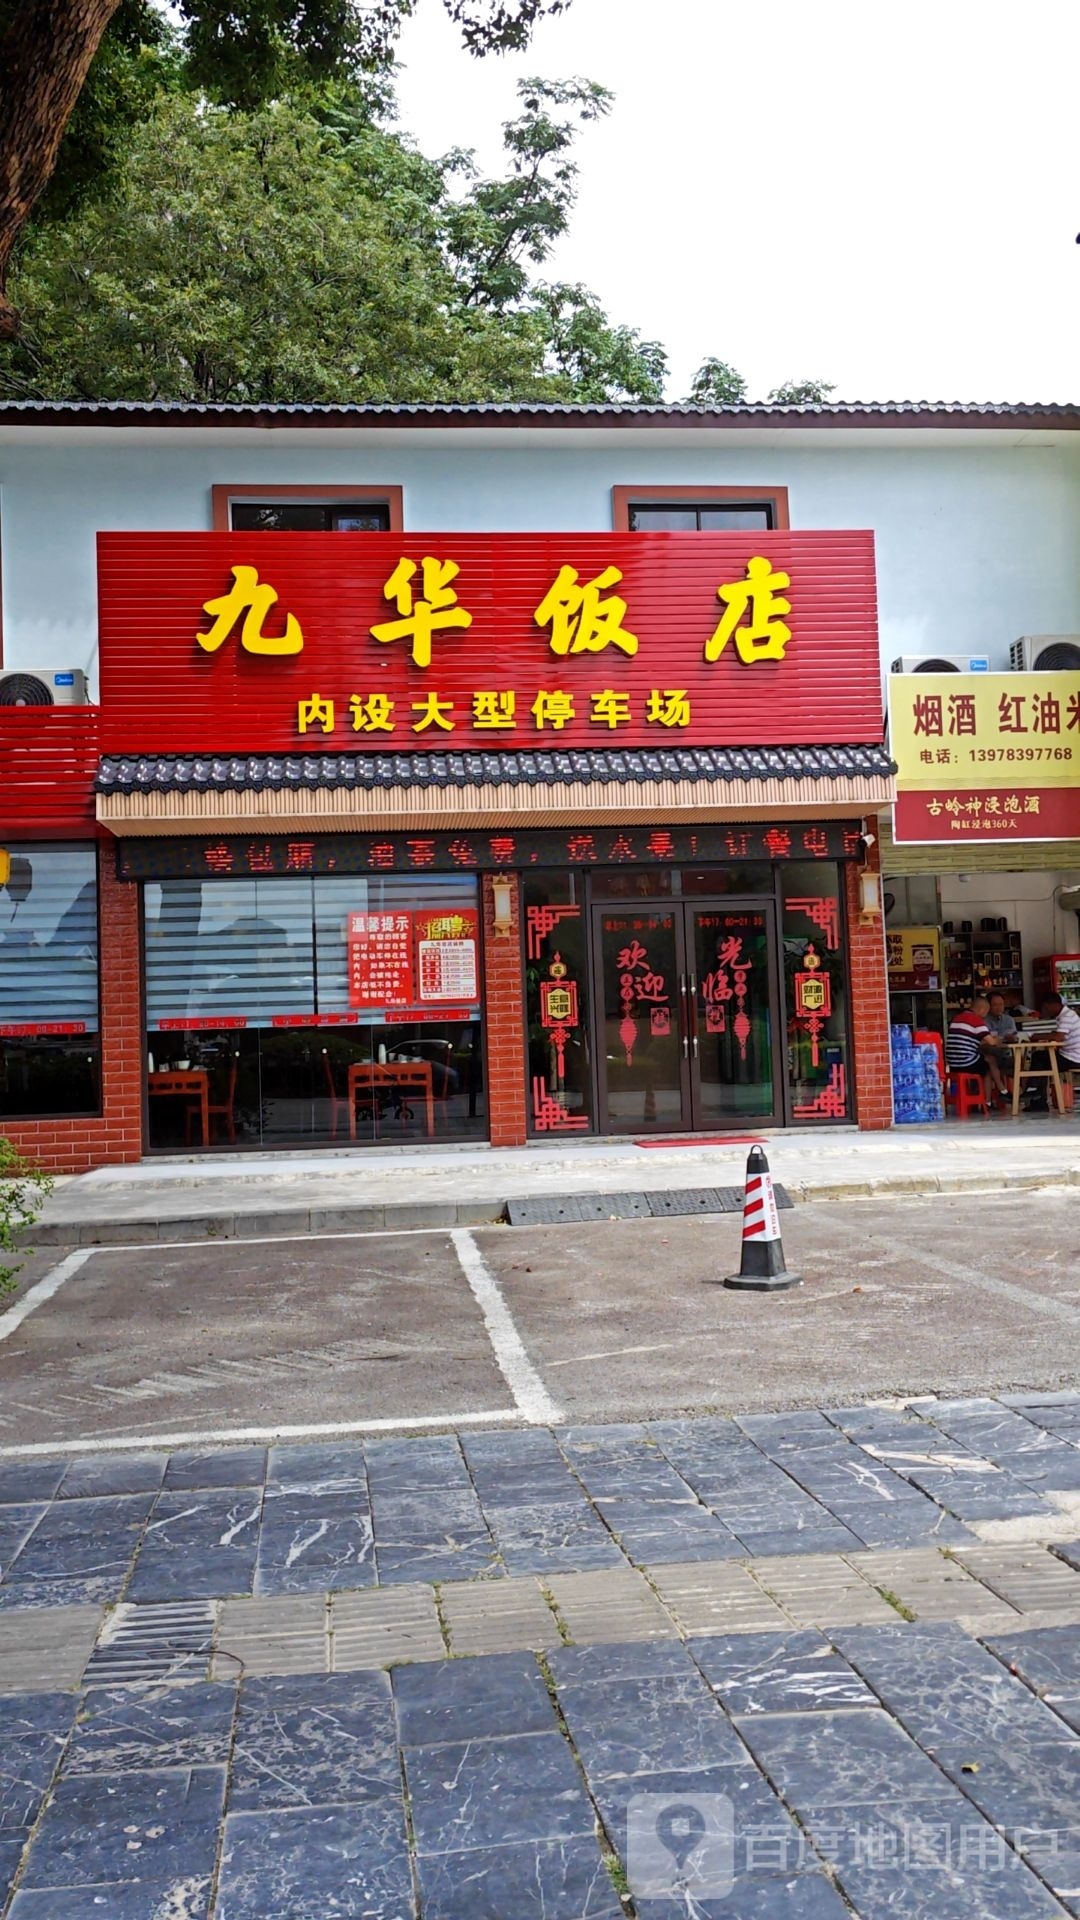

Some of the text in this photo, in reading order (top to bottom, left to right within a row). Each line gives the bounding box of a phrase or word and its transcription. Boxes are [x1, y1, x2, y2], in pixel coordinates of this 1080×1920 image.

[197, 557, 794, 668] 九华饭店
[297, 688, 692, 734] 内设大型停车场
[913, 694, 976, 737] 烟酒
[969, 747, 1073, 763] 13978397768
[352, 916, 409, 932] 温馨提示
